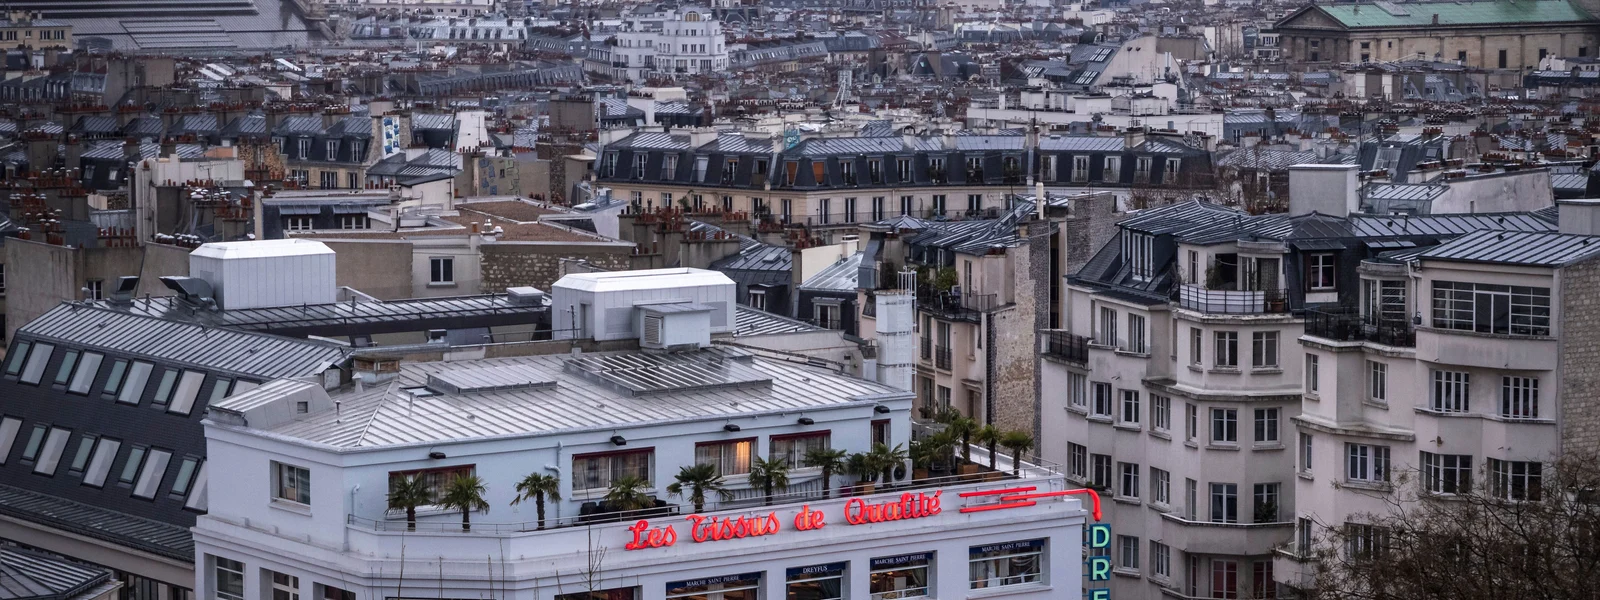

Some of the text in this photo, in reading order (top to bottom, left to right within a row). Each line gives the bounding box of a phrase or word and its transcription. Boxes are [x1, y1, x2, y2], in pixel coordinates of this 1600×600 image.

[625, 489, 943, 550] Les Tissus de Qualité
[895, 555, 909, 563] SAINT
[802, 565, 828, 573] DREYFUS
[707, 577, 722, 585] SAINT
